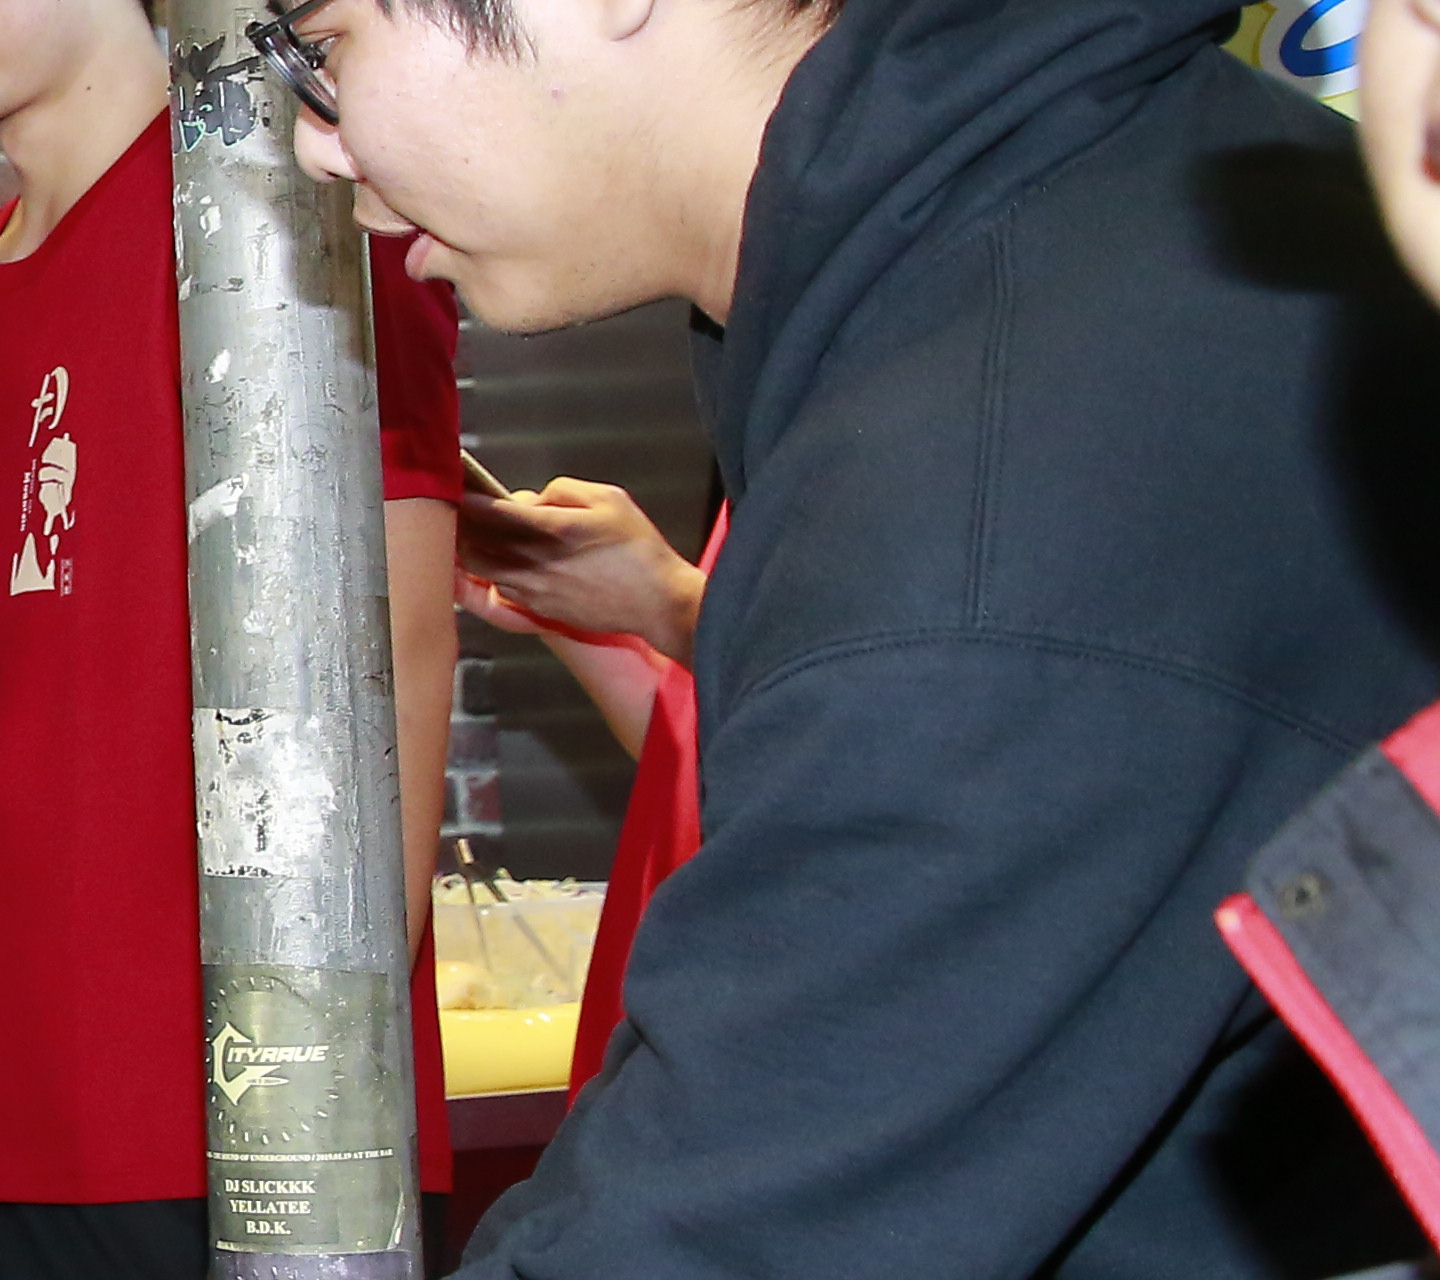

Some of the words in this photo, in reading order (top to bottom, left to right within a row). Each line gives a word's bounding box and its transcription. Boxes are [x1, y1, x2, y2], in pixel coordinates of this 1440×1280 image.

[225, 1179, 240, 1193] DJ
[242, 1180, 316, 1194] SLICKKK
[229, 1199, 311, 1214] YELLATEE
[246, 1221, 292, 1235] B.D.K.
